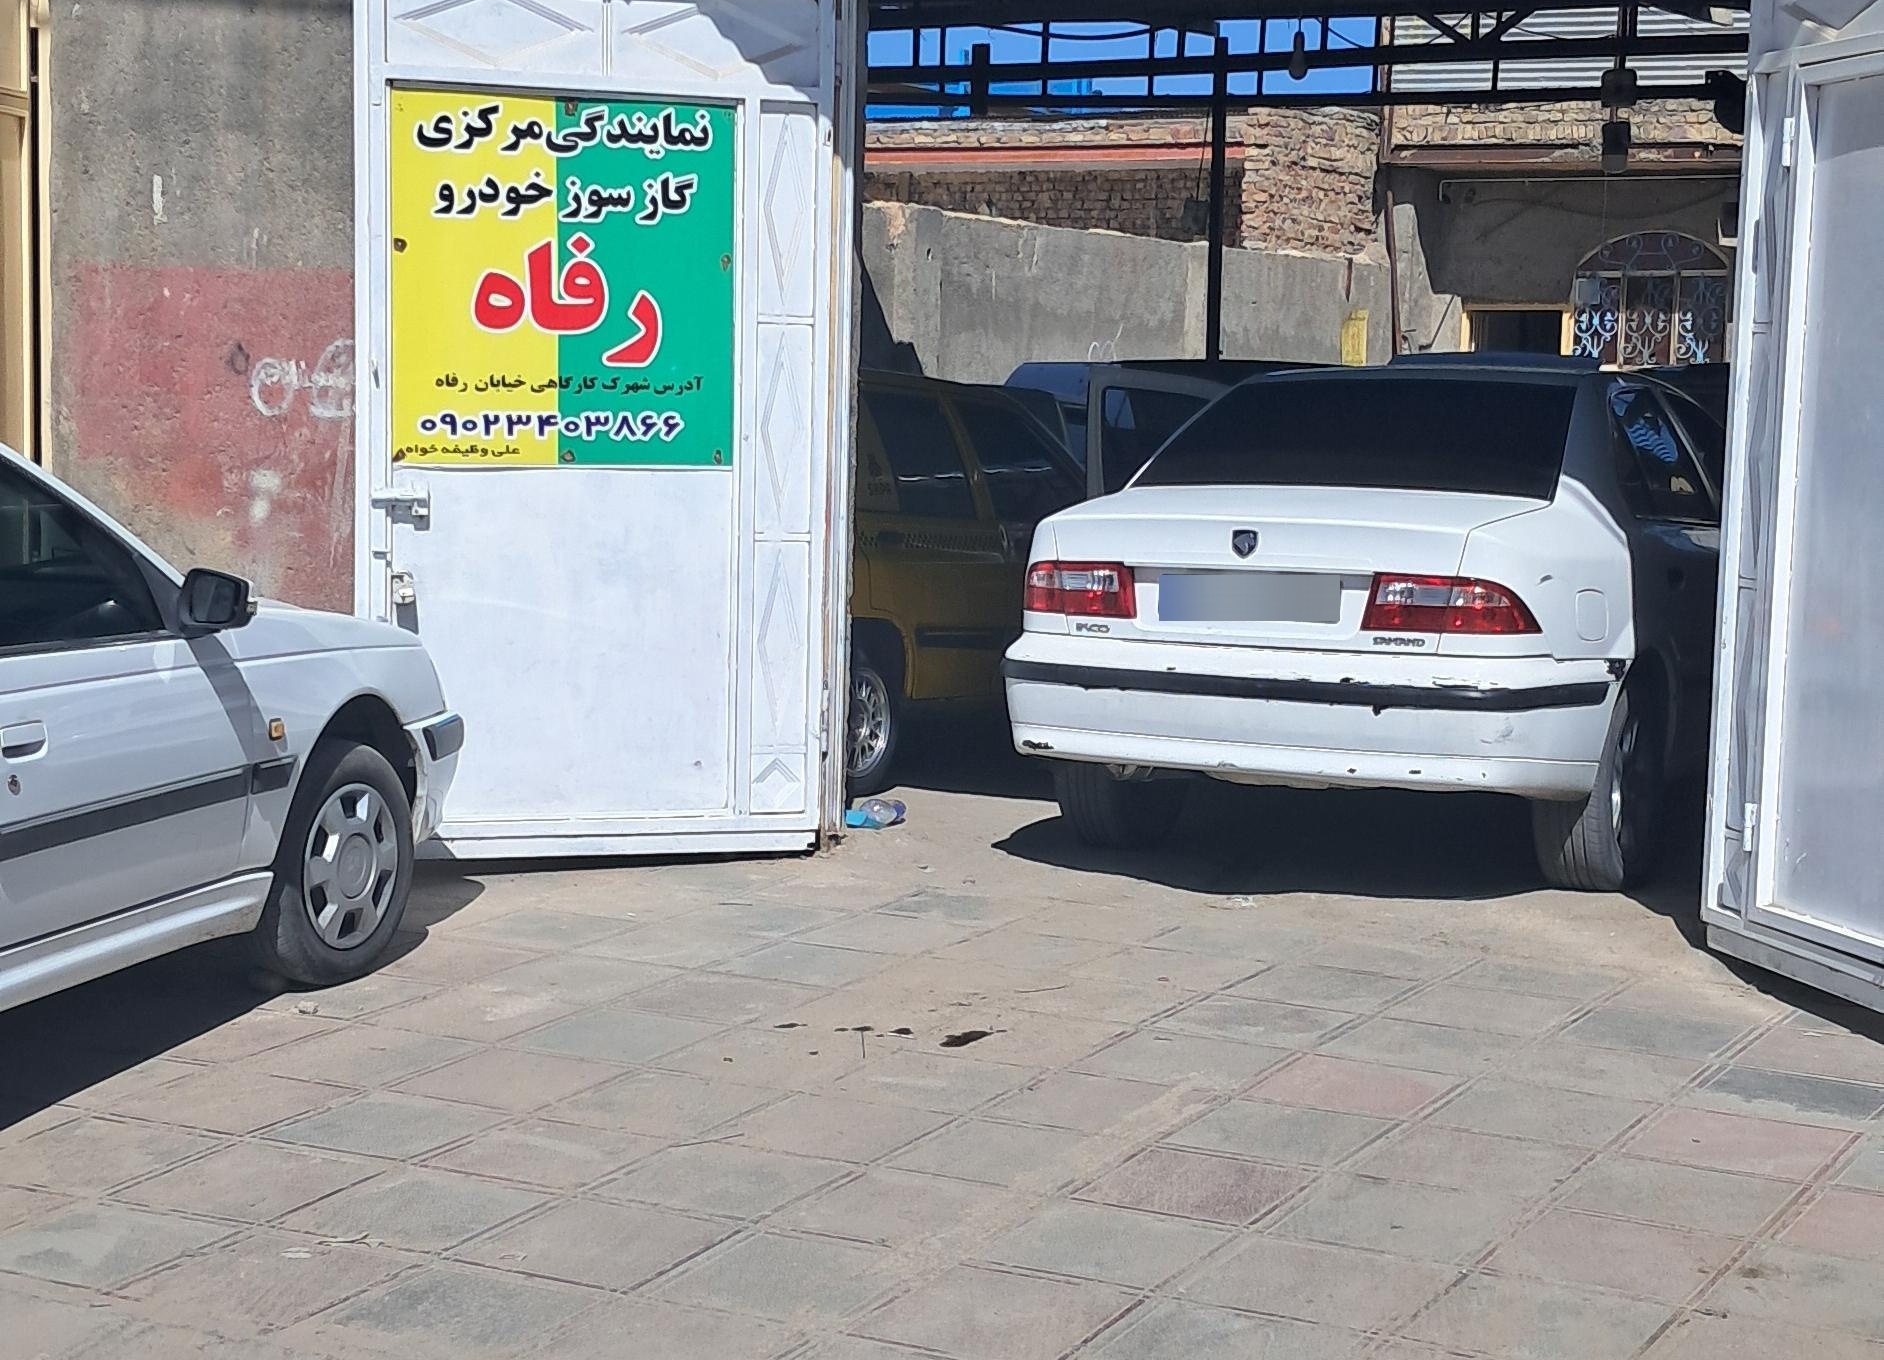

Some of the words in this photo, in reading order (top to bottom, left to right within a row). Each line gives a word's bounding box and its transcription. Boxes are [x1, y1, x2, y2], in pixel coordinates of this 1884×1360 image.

[416, 104, 544, 152] مرکزی
[545, 108, 710, 156] نمایندگی
[433, 170, 554, 217] خودرو
[474, 235, 660, 365] رفاه
[434, 372, 468, 393] رفاه
[474, 375, 527, 393] خیابان
[653, 375, 704, 396] آدرس
